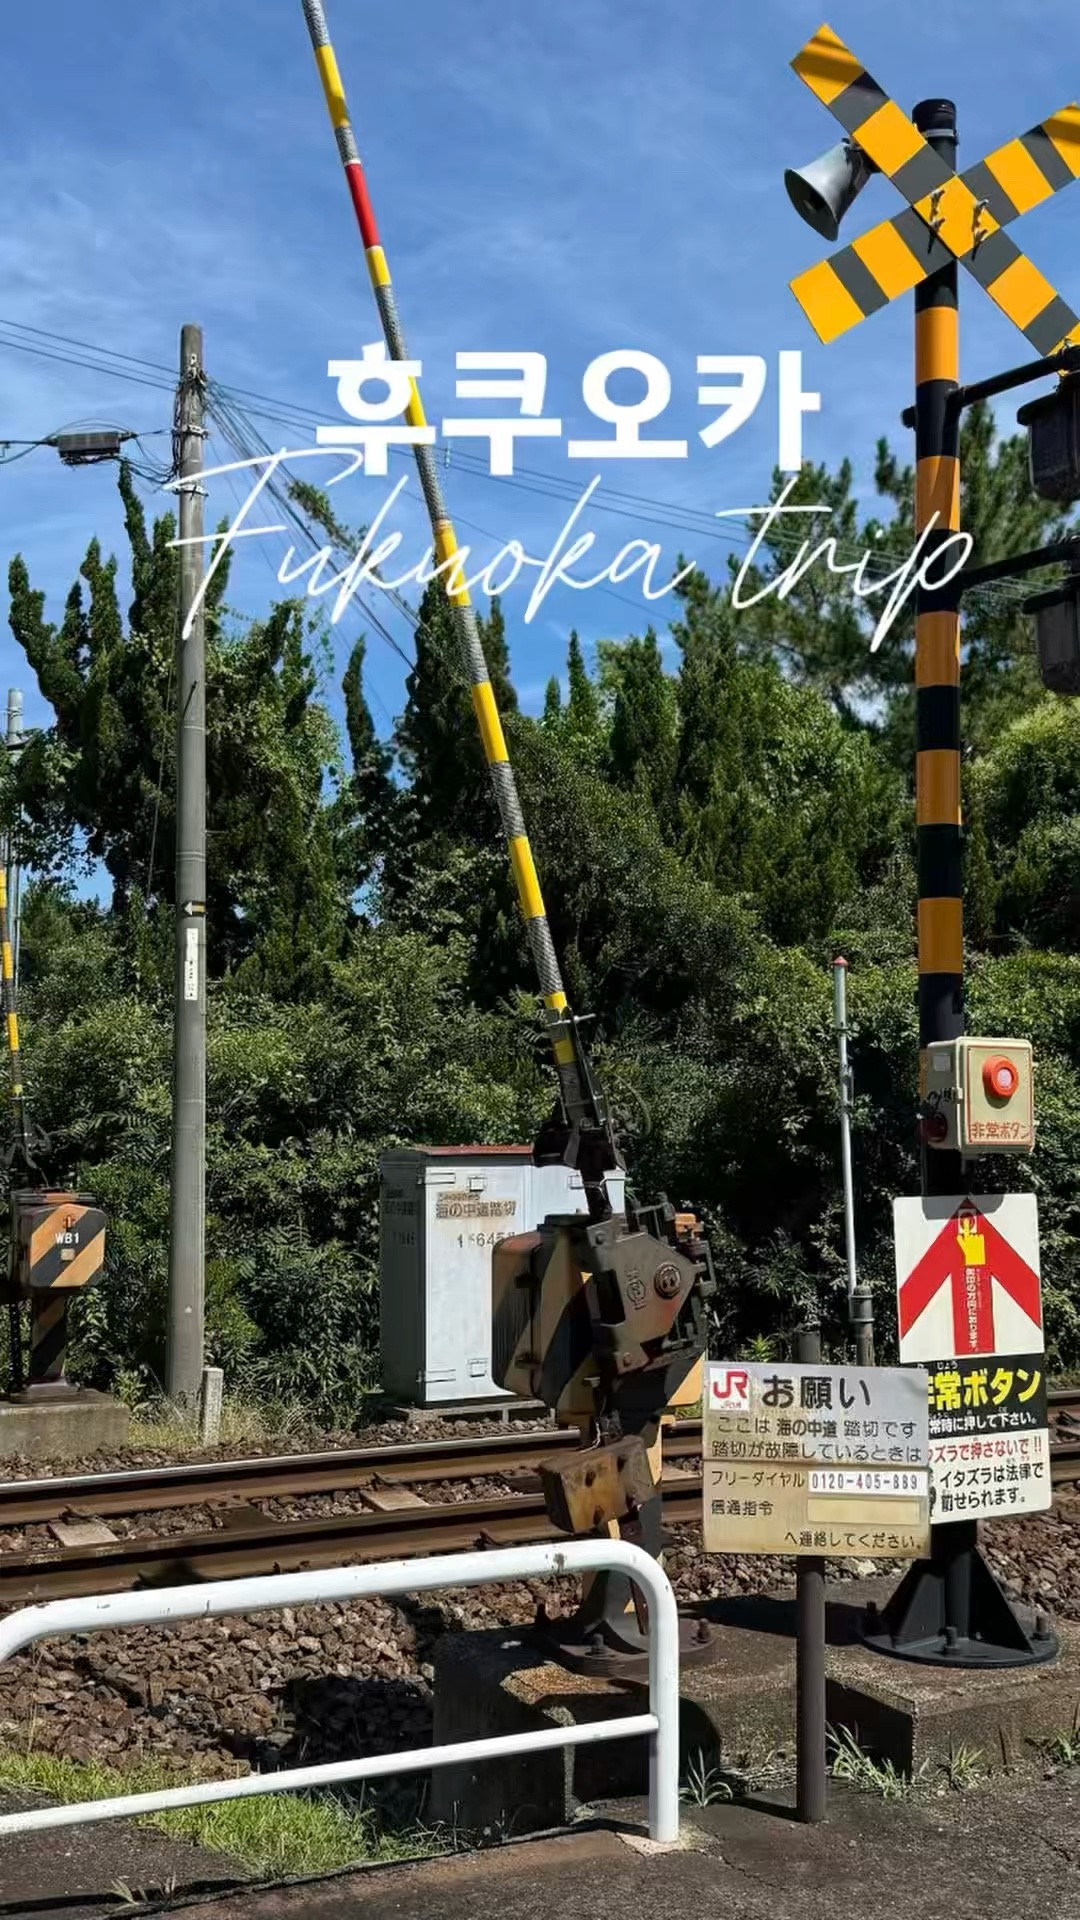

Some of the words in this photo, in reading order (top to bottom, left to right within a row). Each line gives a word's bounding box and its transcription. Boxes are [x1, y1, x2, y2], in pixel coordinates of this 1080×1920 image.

[971, 1121, 1029, 1139] 非常ボタン
[55, 1232, 79, 1244] WB1
[713, 1371, 748, 1398] JR
[761, 1374, 872, 1410] お願い
[711, 1440, 922, 1463] 踏切が故障しているときは
[711, 1470, 805, 1488] フリーダイヤル
[940, 1462, 1044, 1488] イタズラは法律で
[784, 1531, 922, 1549] へ連絡してください。
